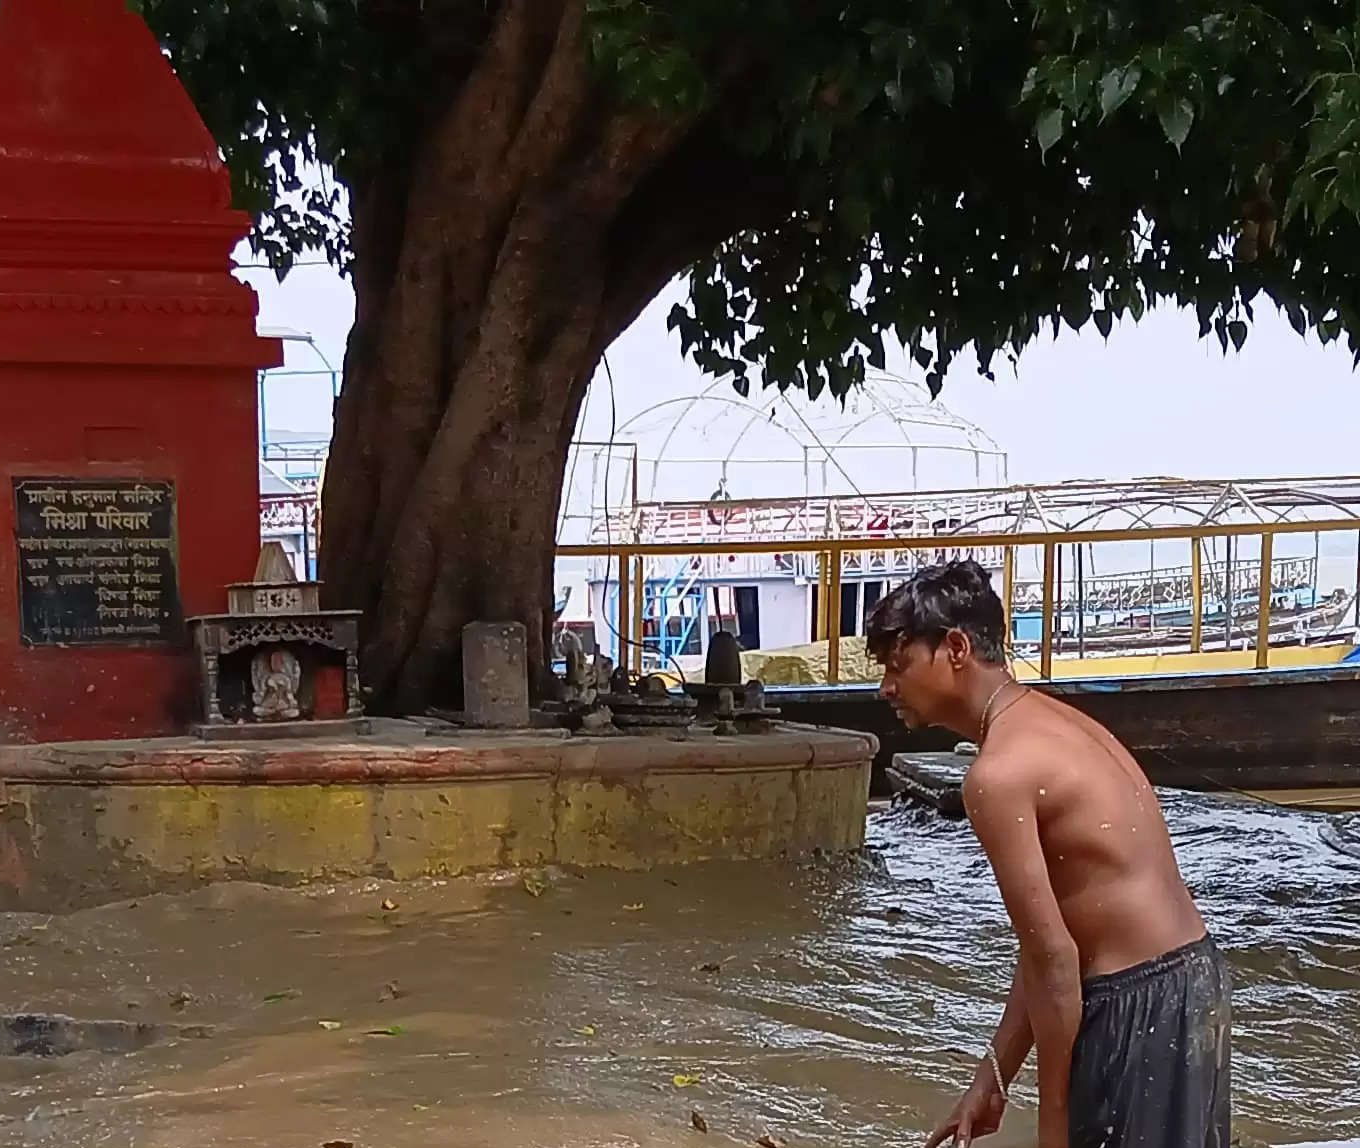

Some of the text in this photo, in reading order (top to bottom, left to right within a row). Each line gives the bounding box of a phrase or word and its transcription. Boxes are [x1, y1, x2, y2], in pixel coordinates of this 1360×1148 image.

[24, 486, 68, 504] प्राचीन
[71, 489, 117, 509] हनुमान
[40, 505, 153, 530] मिश्रा परिवार
